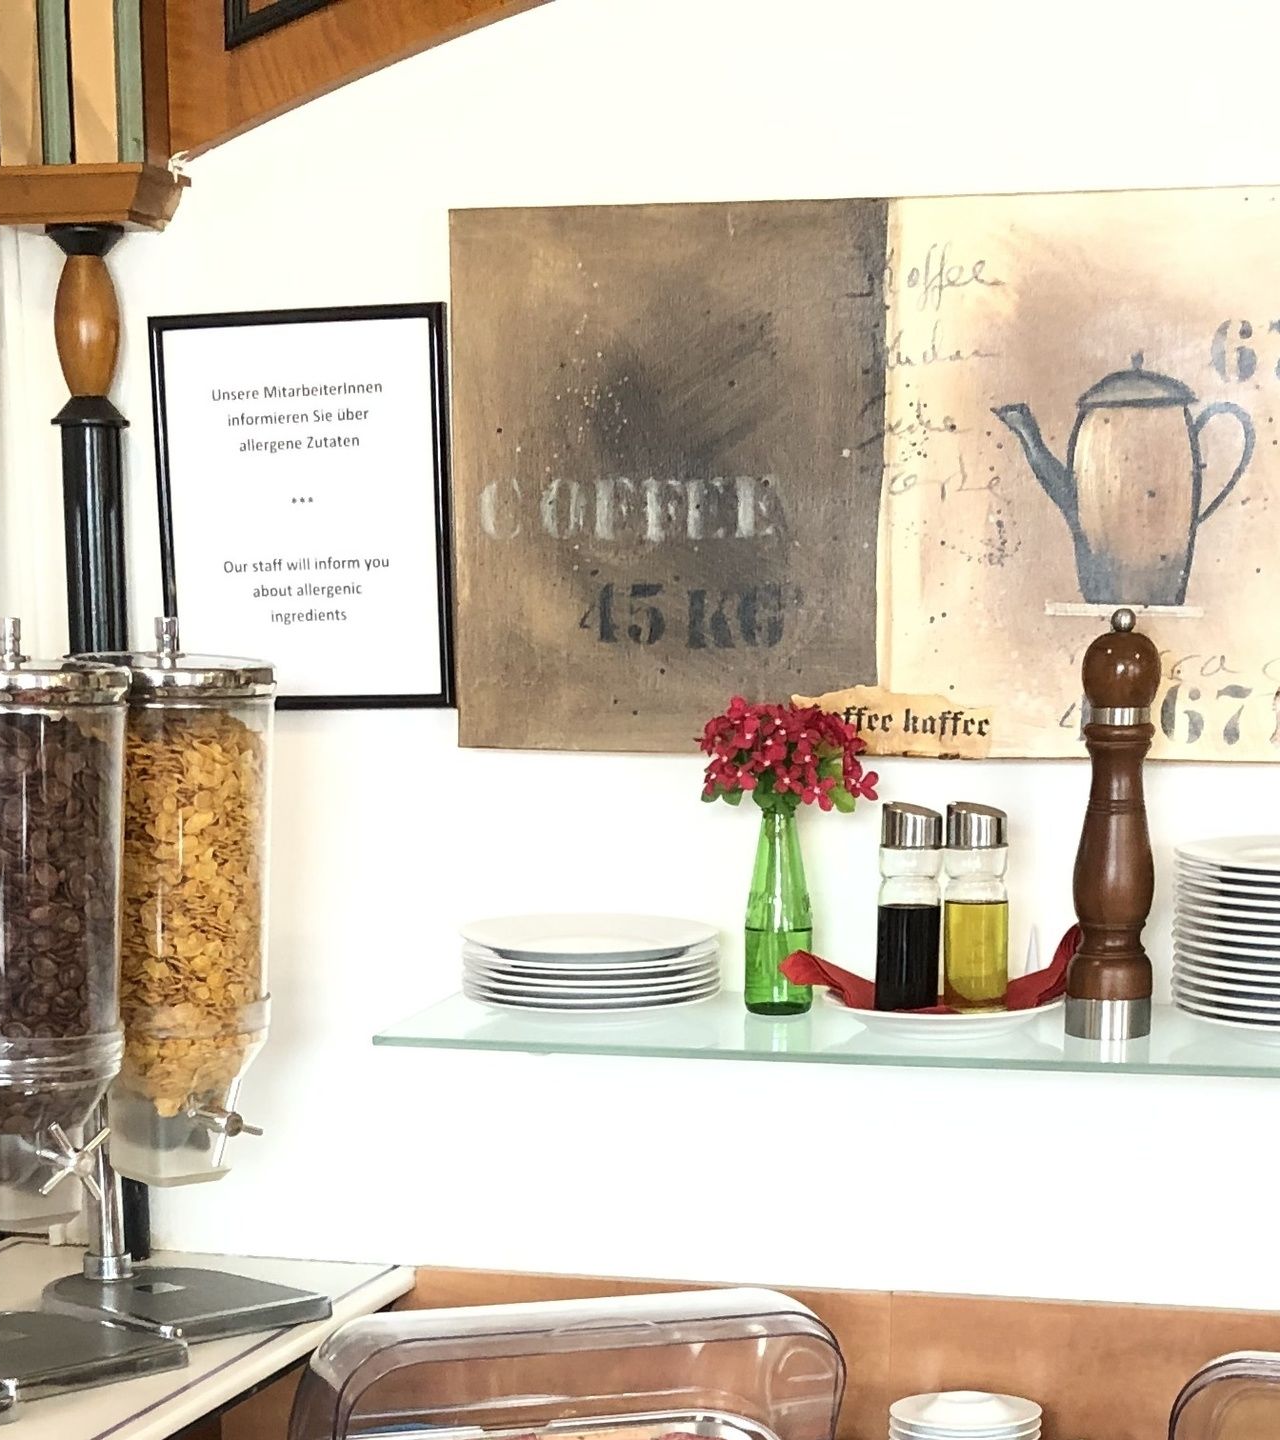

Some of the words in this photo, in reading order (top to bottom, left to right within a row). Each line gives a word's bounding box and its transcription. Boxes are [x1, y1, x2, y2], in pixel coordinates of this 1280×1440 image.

[211, 388, 259, 402] Unsere
[263, 380, 384, 400] MitarbeiterInnen
[228, 413, 309, 427] informieren
[312, 409, 333, 423] Sie
[336, 407, 369, 421] über
[238, 438, 302, 454] allergene
[306, 435, 360, 450] Zutaten
[223, 560, 248, 574] Our
[252, 558, 282, 573] staff
[286, 558, 310, 572] will
[314, 555, 360, 571] inform
[364, 557, 390, 571] you
[253, 584, 292, 598] about
[296, 582, 362, 598] allergenic
[271, 608, 347, 625] ingredients
[579, 582, 666, 646] 45
[685, 580, 785, 649] KG
[903, 707, 991, 742] kaffee
